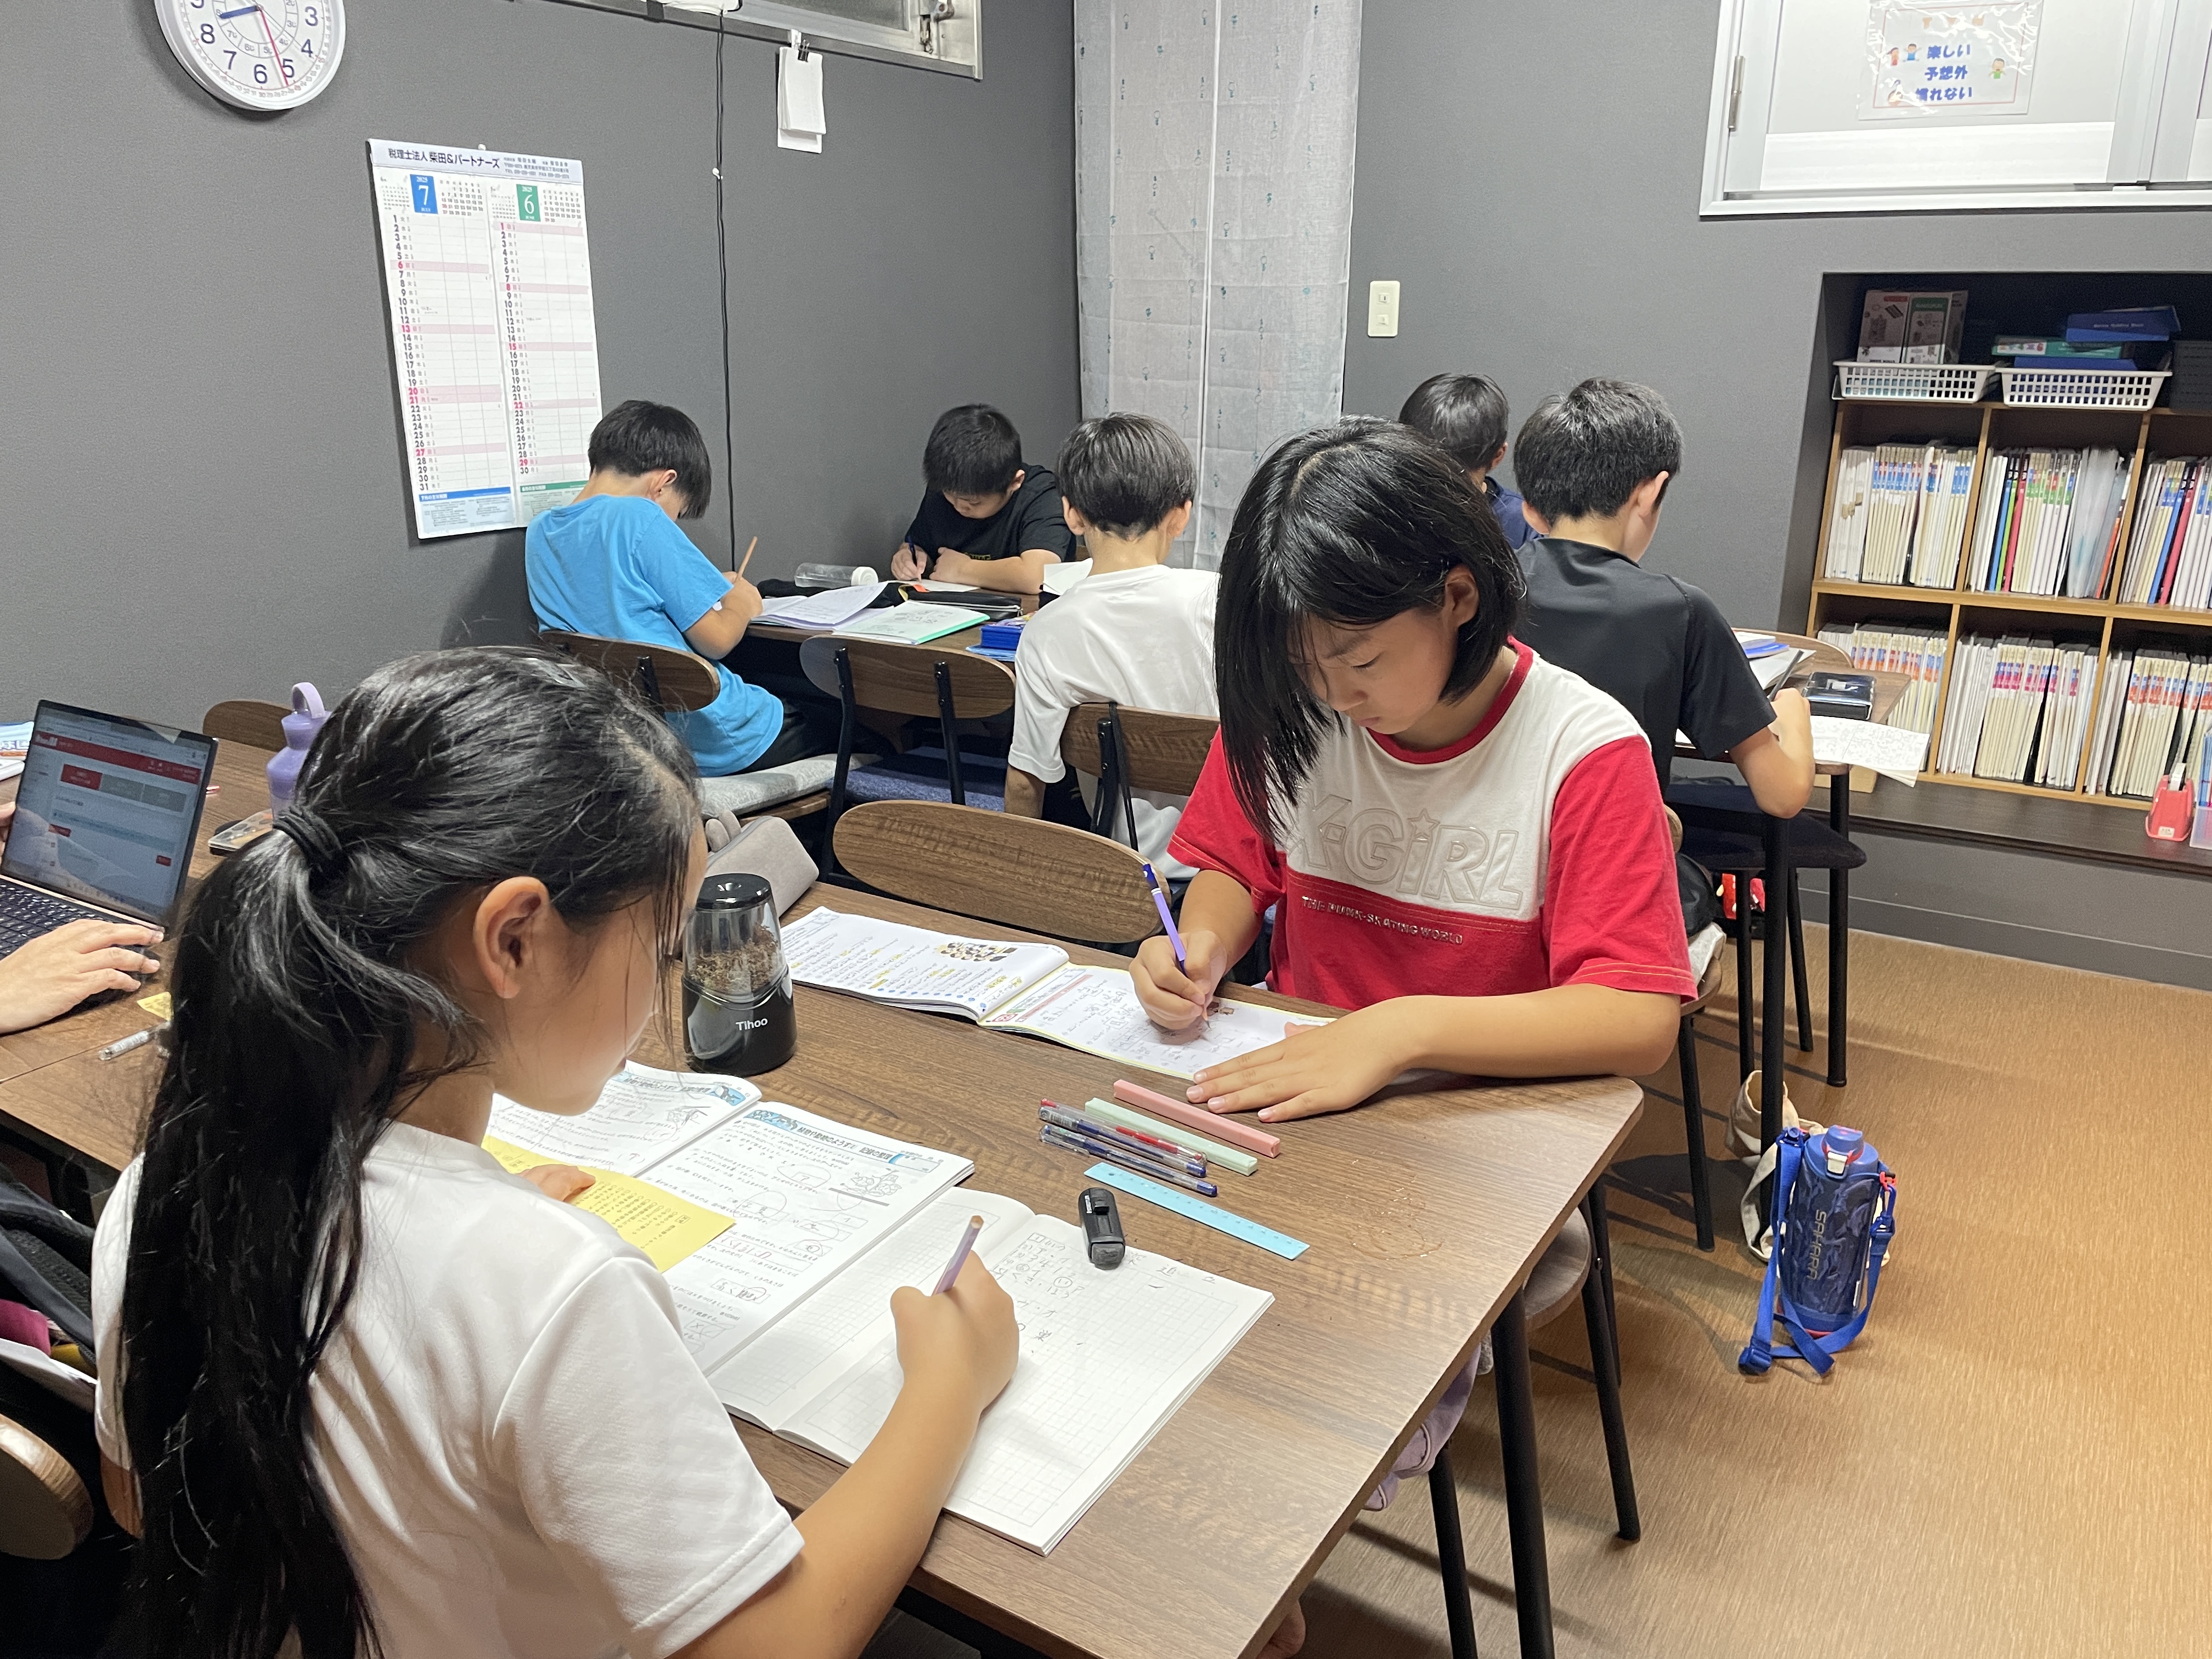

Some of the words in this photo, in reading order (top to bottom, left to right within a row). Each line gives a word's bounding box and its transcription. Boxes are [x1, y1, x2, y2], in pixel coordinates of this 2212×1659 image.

[305, 6, 318, 26] 3
[200, 23, 216, 44] 8
[301, 39, 313, 58] 4
[1927, 44, 1971, 59] 楽しい
[223, 50, 237, 70] 7
[282, 58, 295, 78] 5
[253, 64, 268, 84] 6
[1924, 65, 1968, 81] 予想外
[388, 148, 428, 162] 税理士法人
[418, 185, 429, 206] 7
[524, 194, 534, 215] 6
[393, 215, 397, 223] 1
[1806, 1209, 1827, 1280] SAHARA
